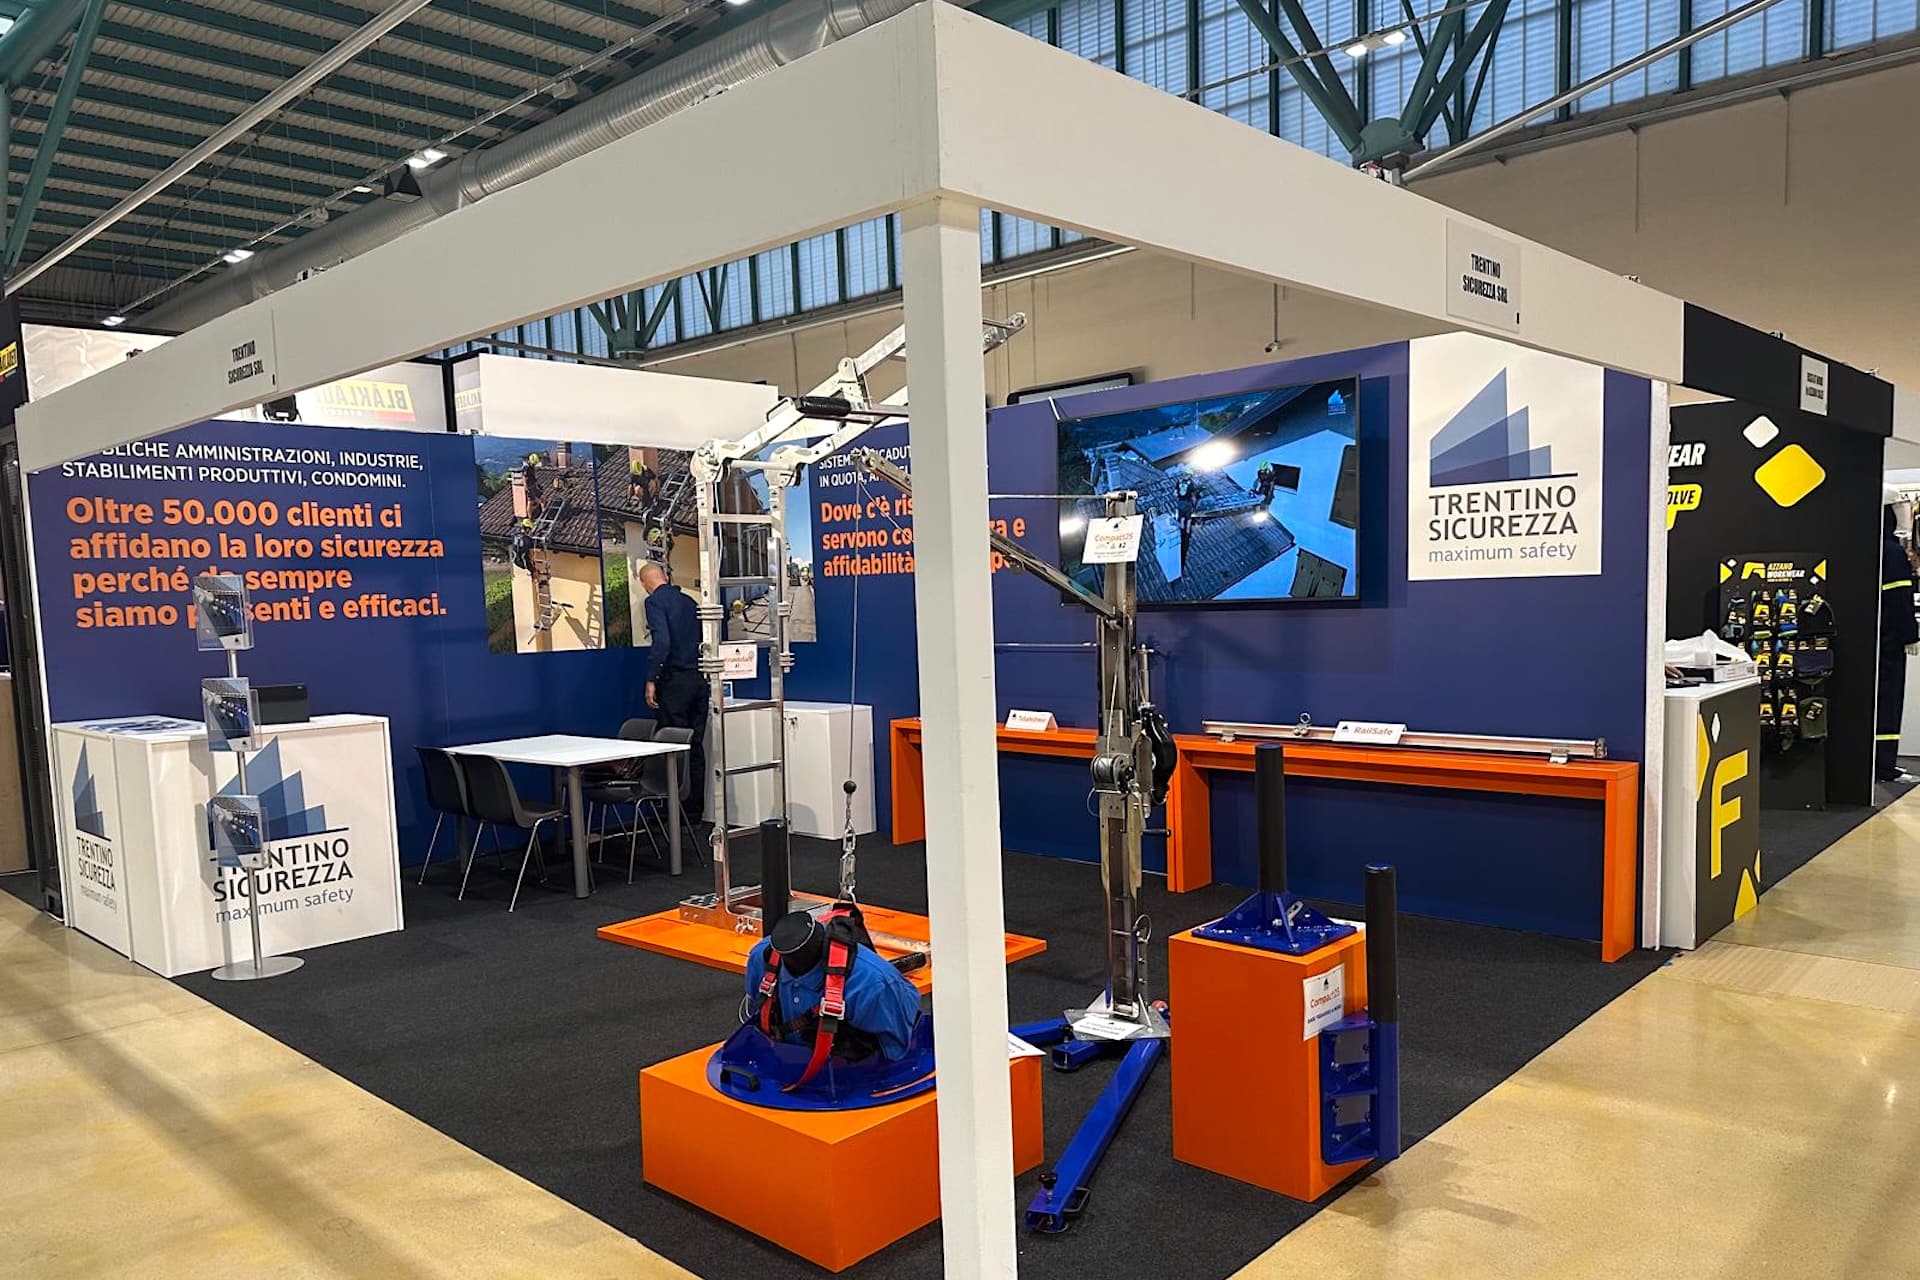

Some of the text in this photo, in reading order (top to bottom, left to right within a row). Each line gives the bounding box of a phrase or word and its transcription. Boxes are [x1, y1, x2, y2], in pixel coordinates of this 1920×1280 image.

[1471, 253, 1500, 279] TRENTINO
[1463, 274, 1507, 304] SICUREZZA SRL
[232, 340, 255, 363] TRENTINO
[175, 443, 336, 467] AMMINISTRAZIONI,
[339, 451, 424, 471] INDUSTRIE,
[1668, 443, 1706, 467] EAR
[62, 461, 406, 488] STABILIMENTI PRODUTTIVI, CONDOMINI.
[819, 474, 829, 488] IN
[831, 471, 867, 486] QUOTA,
[66, 496, 402, 528] Oltre 50.000 clienti ci
[820, 502, 862, 523] Dove
[866, 495, 890, 519] c'è
[1428, 485, 1577, 516] TRENTINO
[822, 528, 888, 550] servono
[1013, 518, 1026, 537] e
[1428, 511, 1578, 541] SICUREZZA
[70, 532, 444, 559] affidano la loro sicurezza
[1428, 541, 1577, 563] maximum safety
[823, 551, 914, 577] affidabilità
[1767, 570, 1805, 578] WORKWEAR
[72, 565, 189, 599] perché
[245, 569, 352, 593] sempre
[75, 601, 178, 628] siamo
[318, 600, 336, 619] e
[342, 592, 447, 619] efficaci.
[1354, 727, 1393, 736] RailSafe
[77, 836, 114, 867] TRENTINO
[79, 857, 116, 892] SICUREZZA
[213, 860, 353, 902] SICUREZZA
[215, 887, 354, 923] maxmum safety
